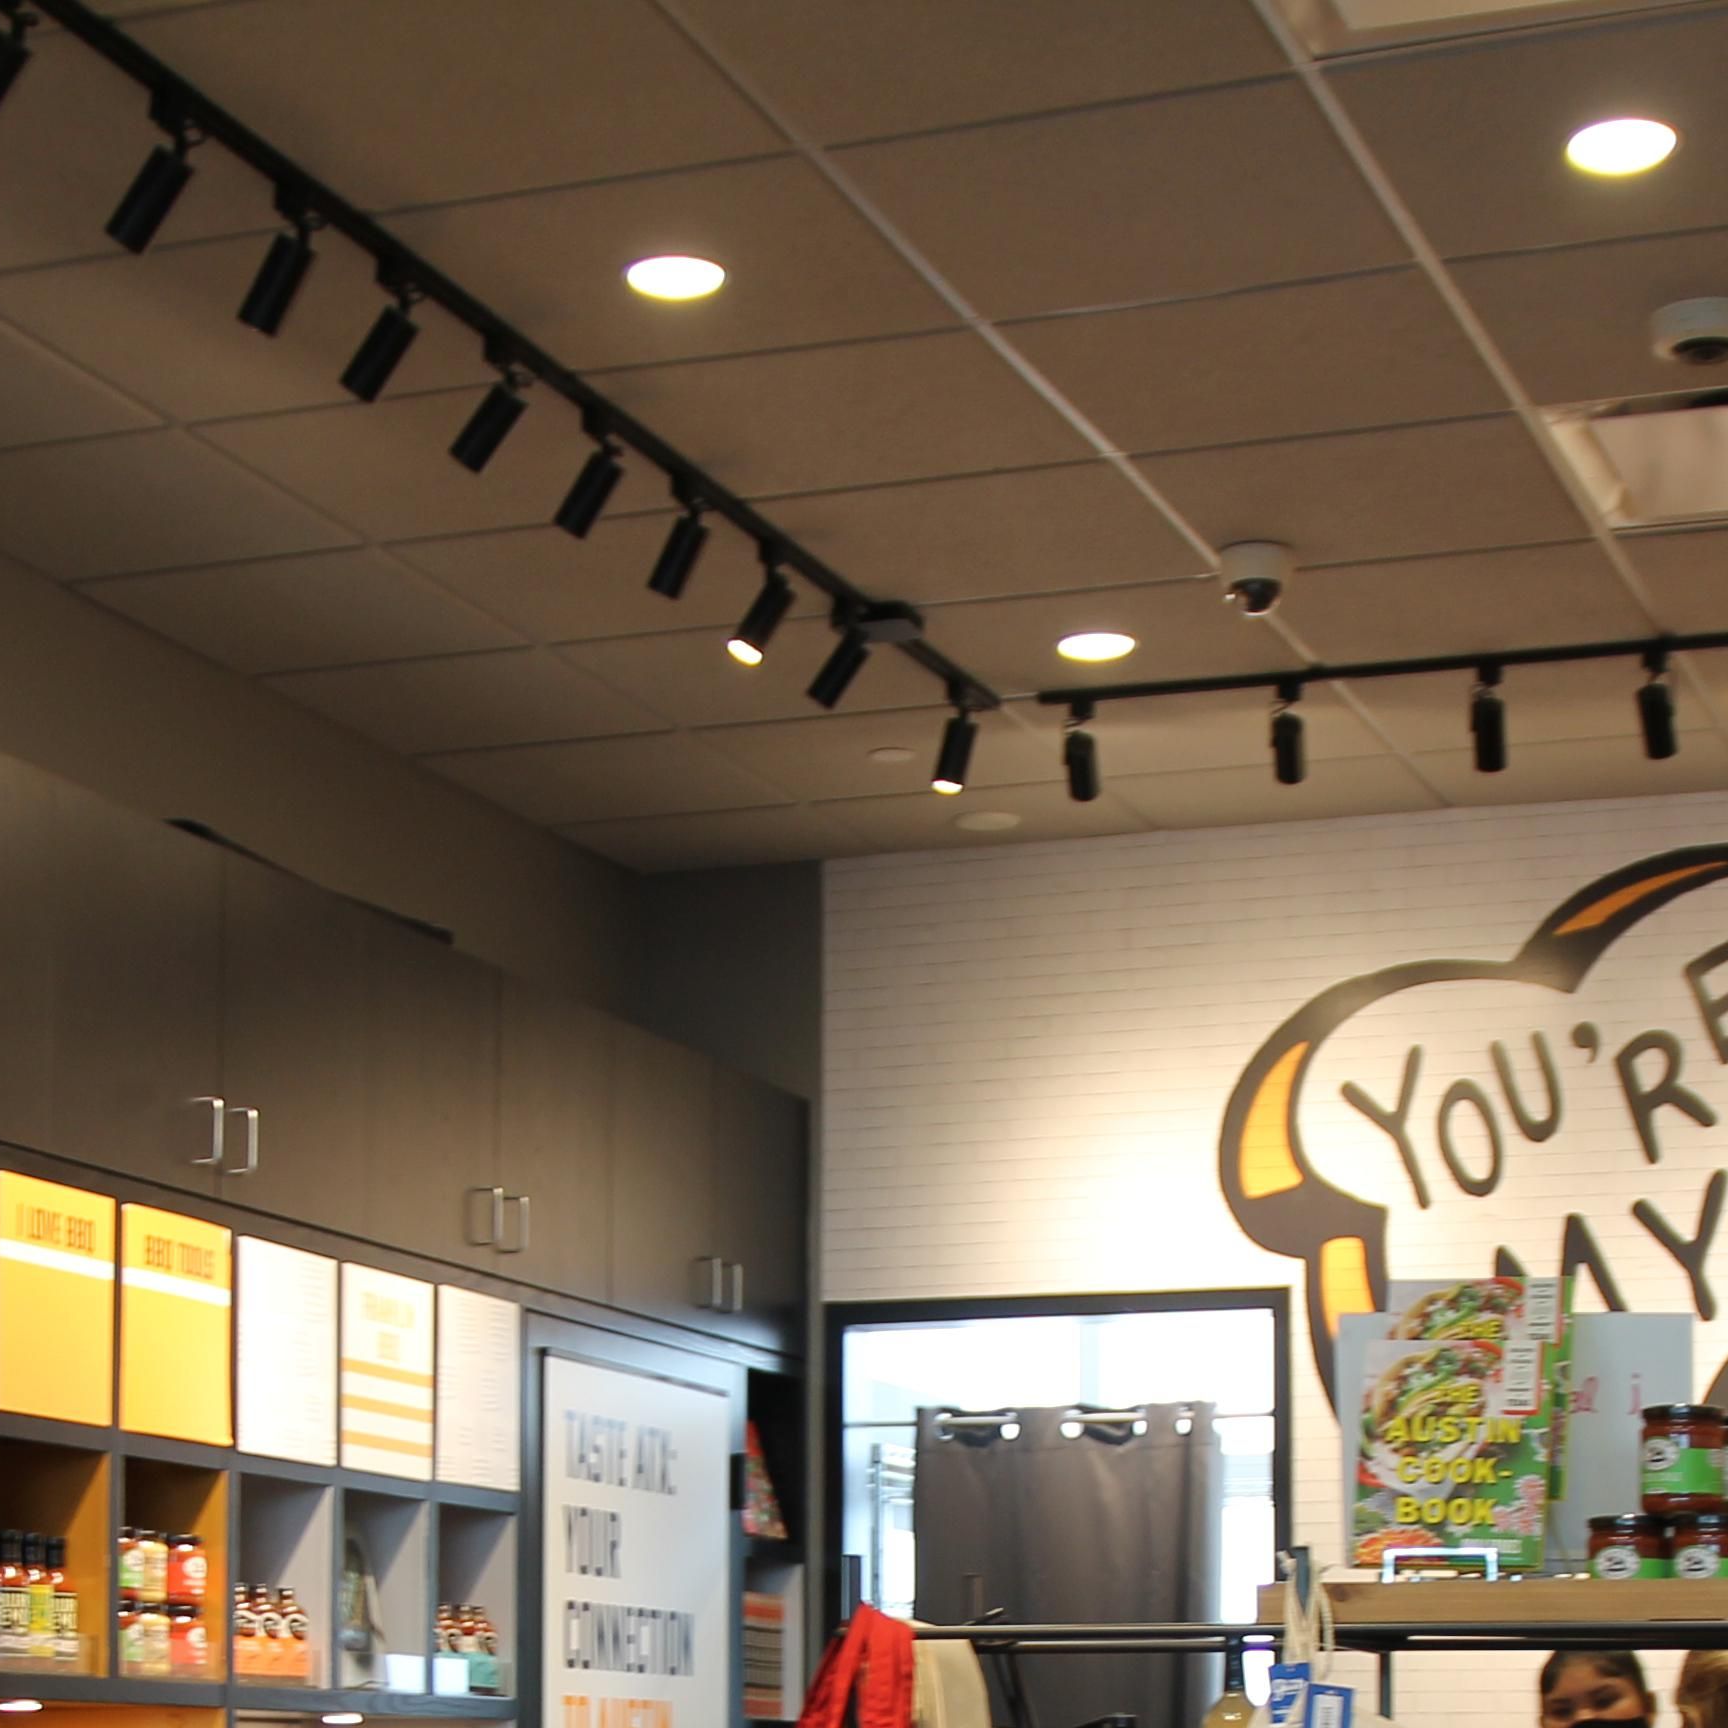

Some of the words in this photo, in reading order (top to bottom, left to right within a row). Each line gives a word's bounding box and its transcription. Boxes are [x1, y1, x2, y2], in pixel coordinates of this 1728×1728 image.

[66, 1214, 97, 1255] BBQ
[145, 1234, 173, 1271] BBQ
[1385, 1415, 1522, 1444] AUSTIN
[1395, 1456, 1514, 1485] COOK-
[1394, 1497, 1498, 1526] BOOK
[562, 1504, 622, 1579] YOUR
[563, 1600, 696, 1677] CONNECTION
